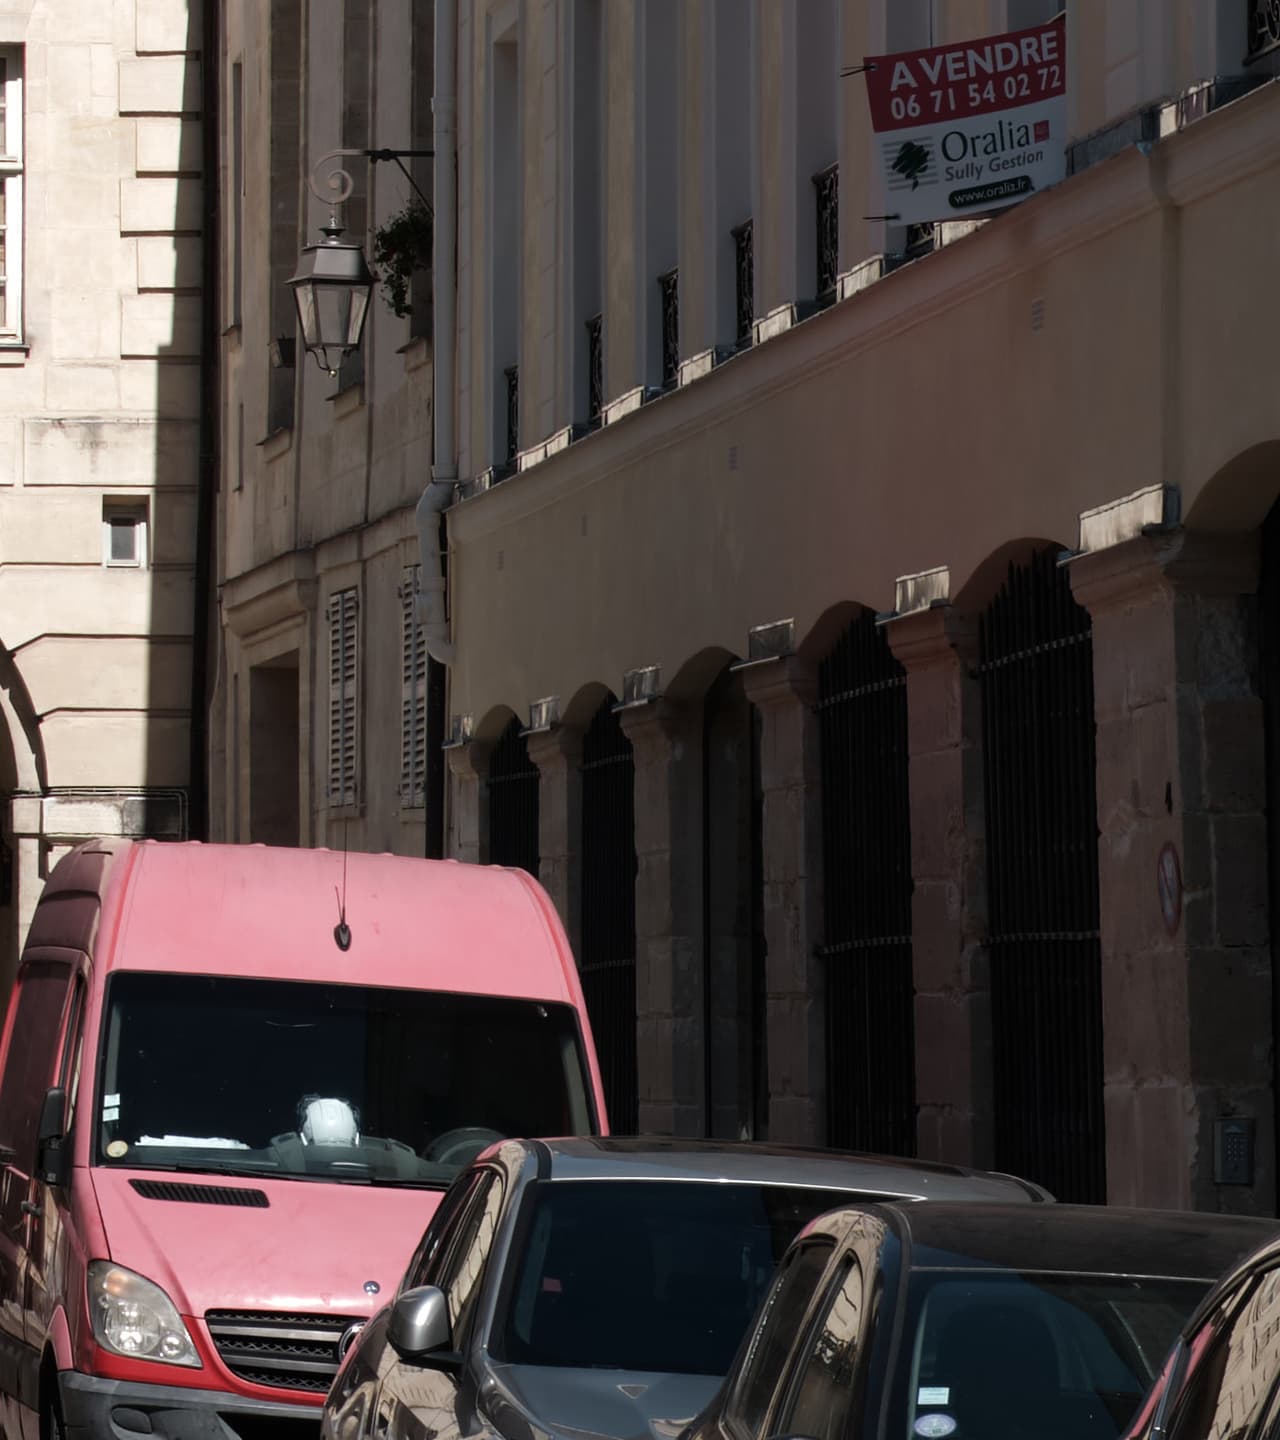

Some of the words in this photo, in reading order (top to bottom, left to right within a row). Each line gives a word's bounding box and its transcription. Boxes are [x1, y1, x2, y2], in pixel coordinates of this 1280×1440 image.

[890, 61, 918, 91] A
[918, 31, 1058, 85] VENDRE
[891, 94, 921, 120] 06
[930, 88, 956, 113] 71
[968, 80, 997, 107] 54
[1003, 73, 1031, 99] 02
[1037, 65, 1062, 91] 72
[941, 120, 1030, 161] Oralia
[944, 162, 983, 182] Sully
[989, 150, 1043, 172] Gestion
[953, 178, 1027, 205] www.oralia.fr
